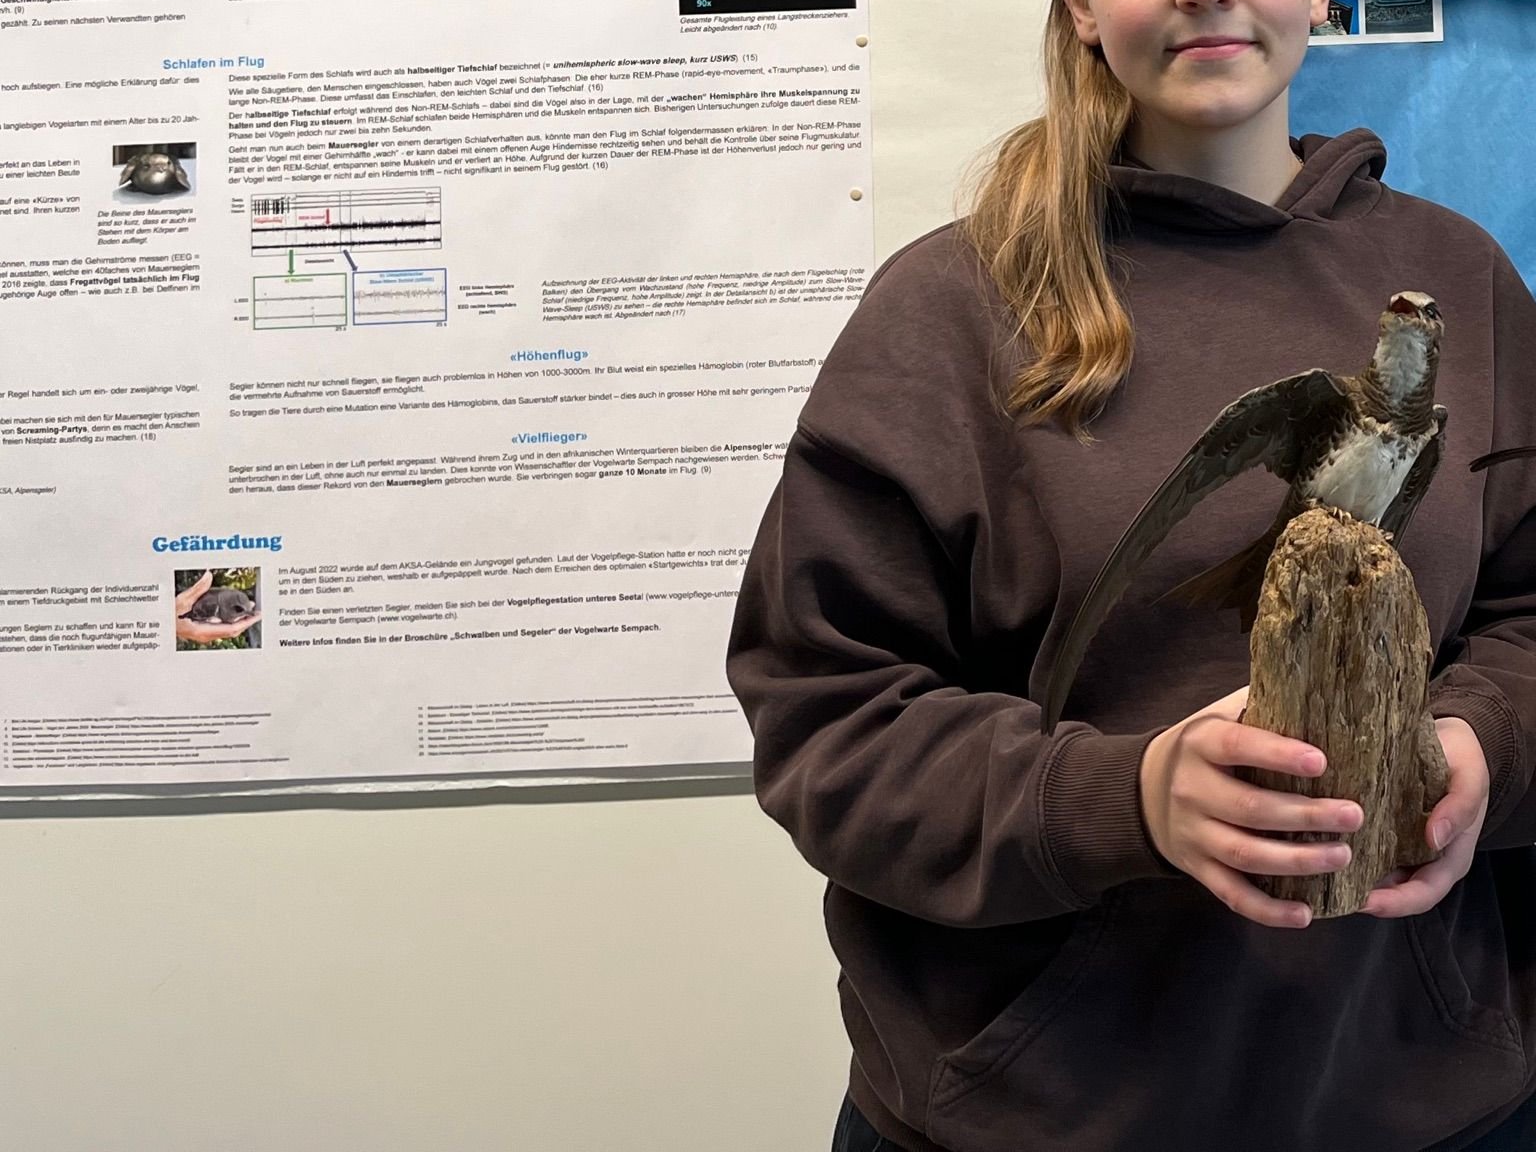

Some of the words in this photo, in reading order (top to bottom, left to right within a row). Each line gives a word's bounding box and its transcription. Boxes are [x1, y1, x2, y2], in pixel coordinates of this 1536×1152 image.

[696, 0, 712, 7] 90x
[162, 58, 216, 69] Schlafen
[219, 57, 234, 67] im
[238, 56, 264, 68] Flug
[510, 349, 588, 361] «Höhenflug»
[511, 432, 587, 444] «Vielflieger»
[152, 534, 282, 552] Gefährdung
